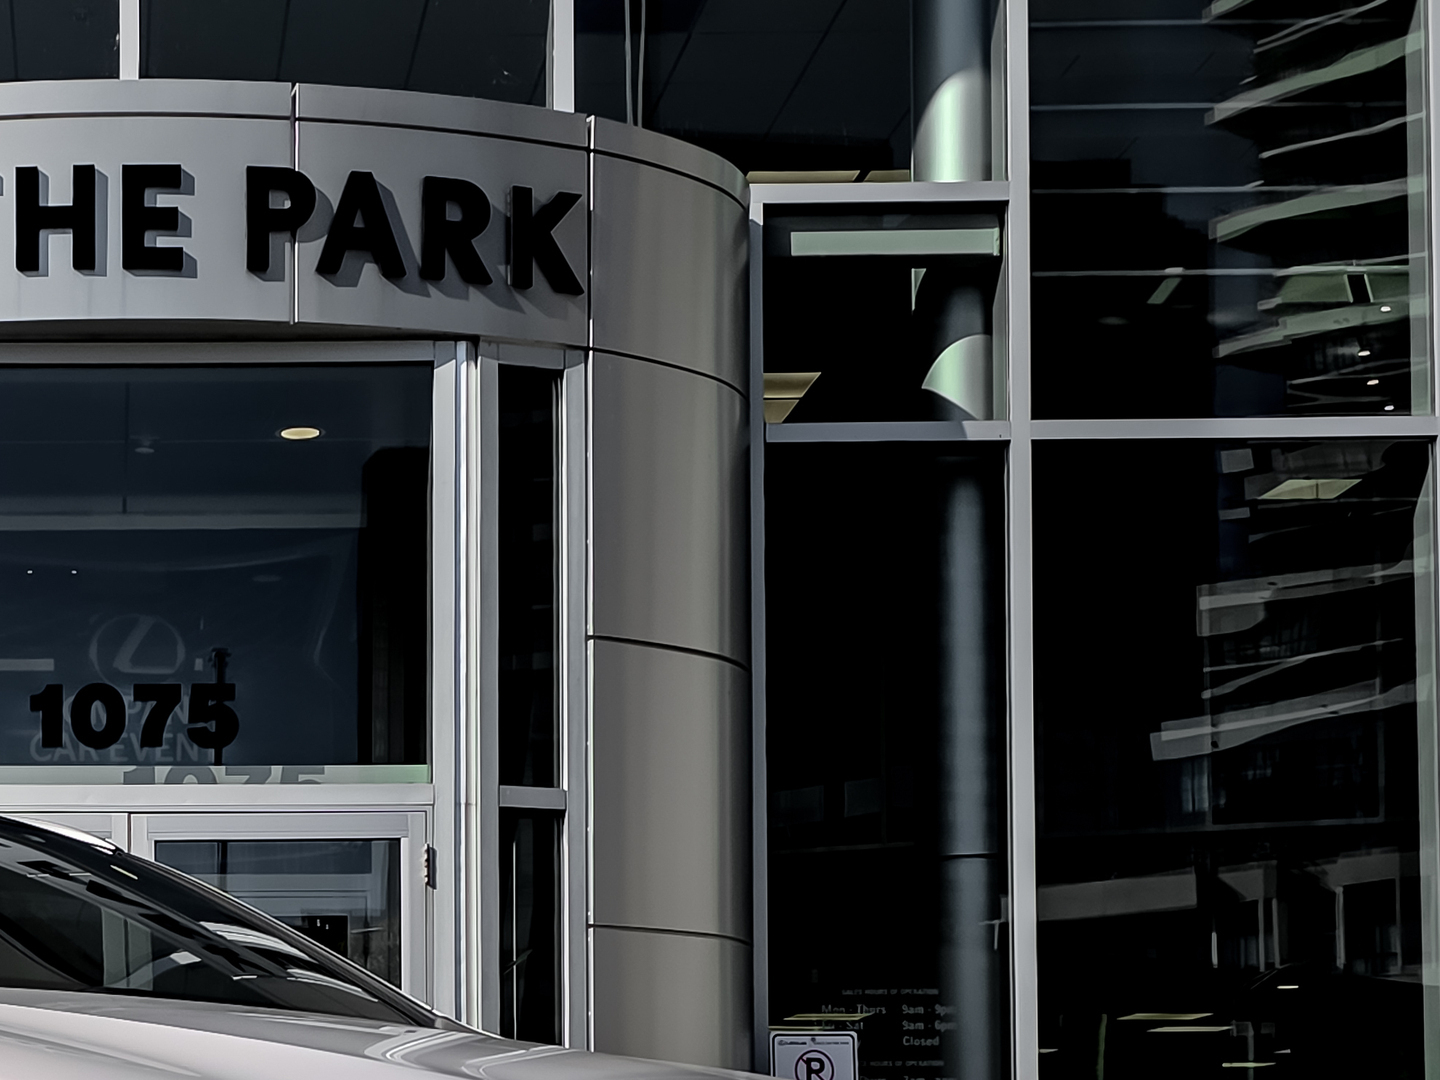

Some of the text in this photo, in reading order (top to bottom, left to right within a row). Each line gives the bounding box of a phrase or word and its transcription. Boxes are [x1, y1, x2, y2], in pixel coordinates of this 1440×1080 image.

[245, 163, 587, 298] PARK
[29, 682, 240, 750] 1075
[902, 1036, 940, 1047] Closed
